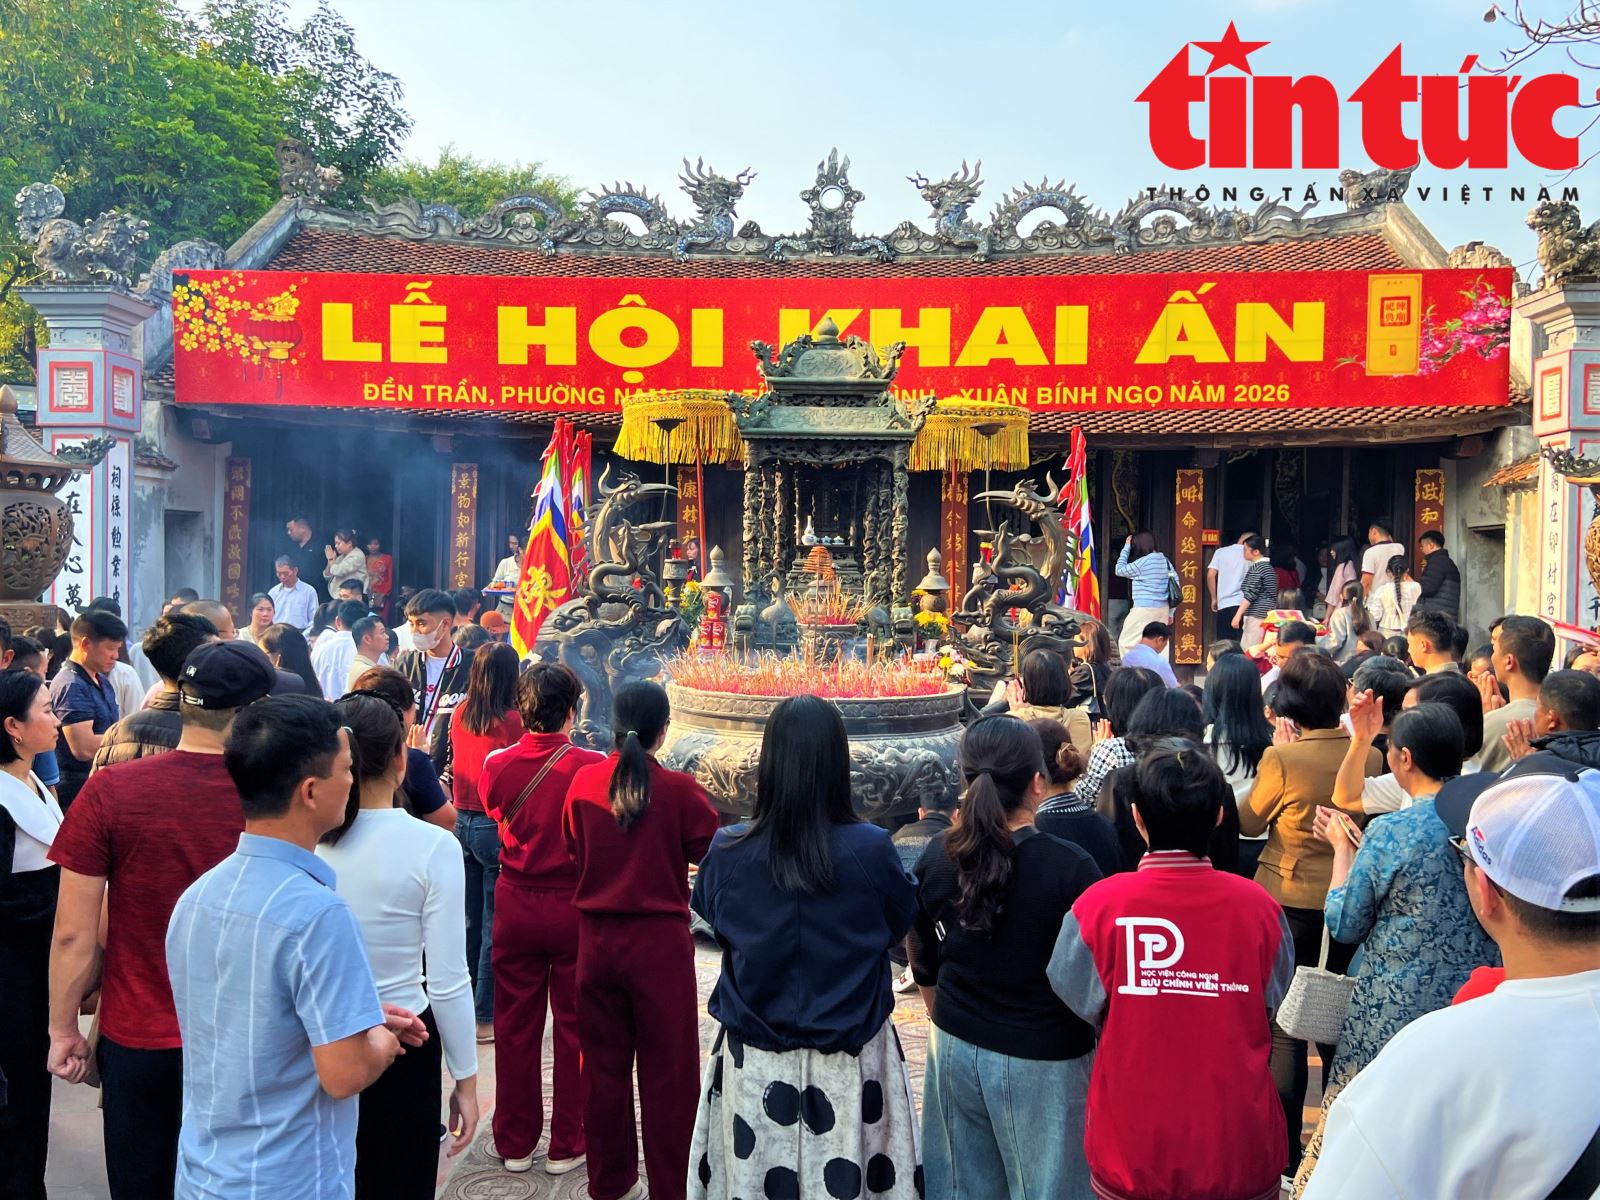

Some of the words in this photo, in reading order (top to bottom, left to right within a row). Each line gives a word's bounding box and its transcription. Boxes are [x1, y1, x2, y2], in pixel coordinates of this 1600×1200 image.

[322, 281, 449, 364] LỄ
[497, 294, 724, 382] HỘI
[1134, 282, 1325, 364] ẤN
[363, 377, 413, 402] ĐỀN
[422, 378, 495, 406] TRẦN,
[502, 383, 605, 405] PHƯỜNG
[960, 383, 1027, 406] XUÂN
[1037, 382, 1097, 405] BÍNH
[1107, 385, 1163, 408] NGỌ
[1170, 380, 1226, 404] NĂM
[1234, 385, 1290, 402] 2026
[1158, 969, 1175, 978] VIỆN
[1176, 970, 1197, 979] CÔNG
[1162, 978, 1193, 988] CHÍNH
